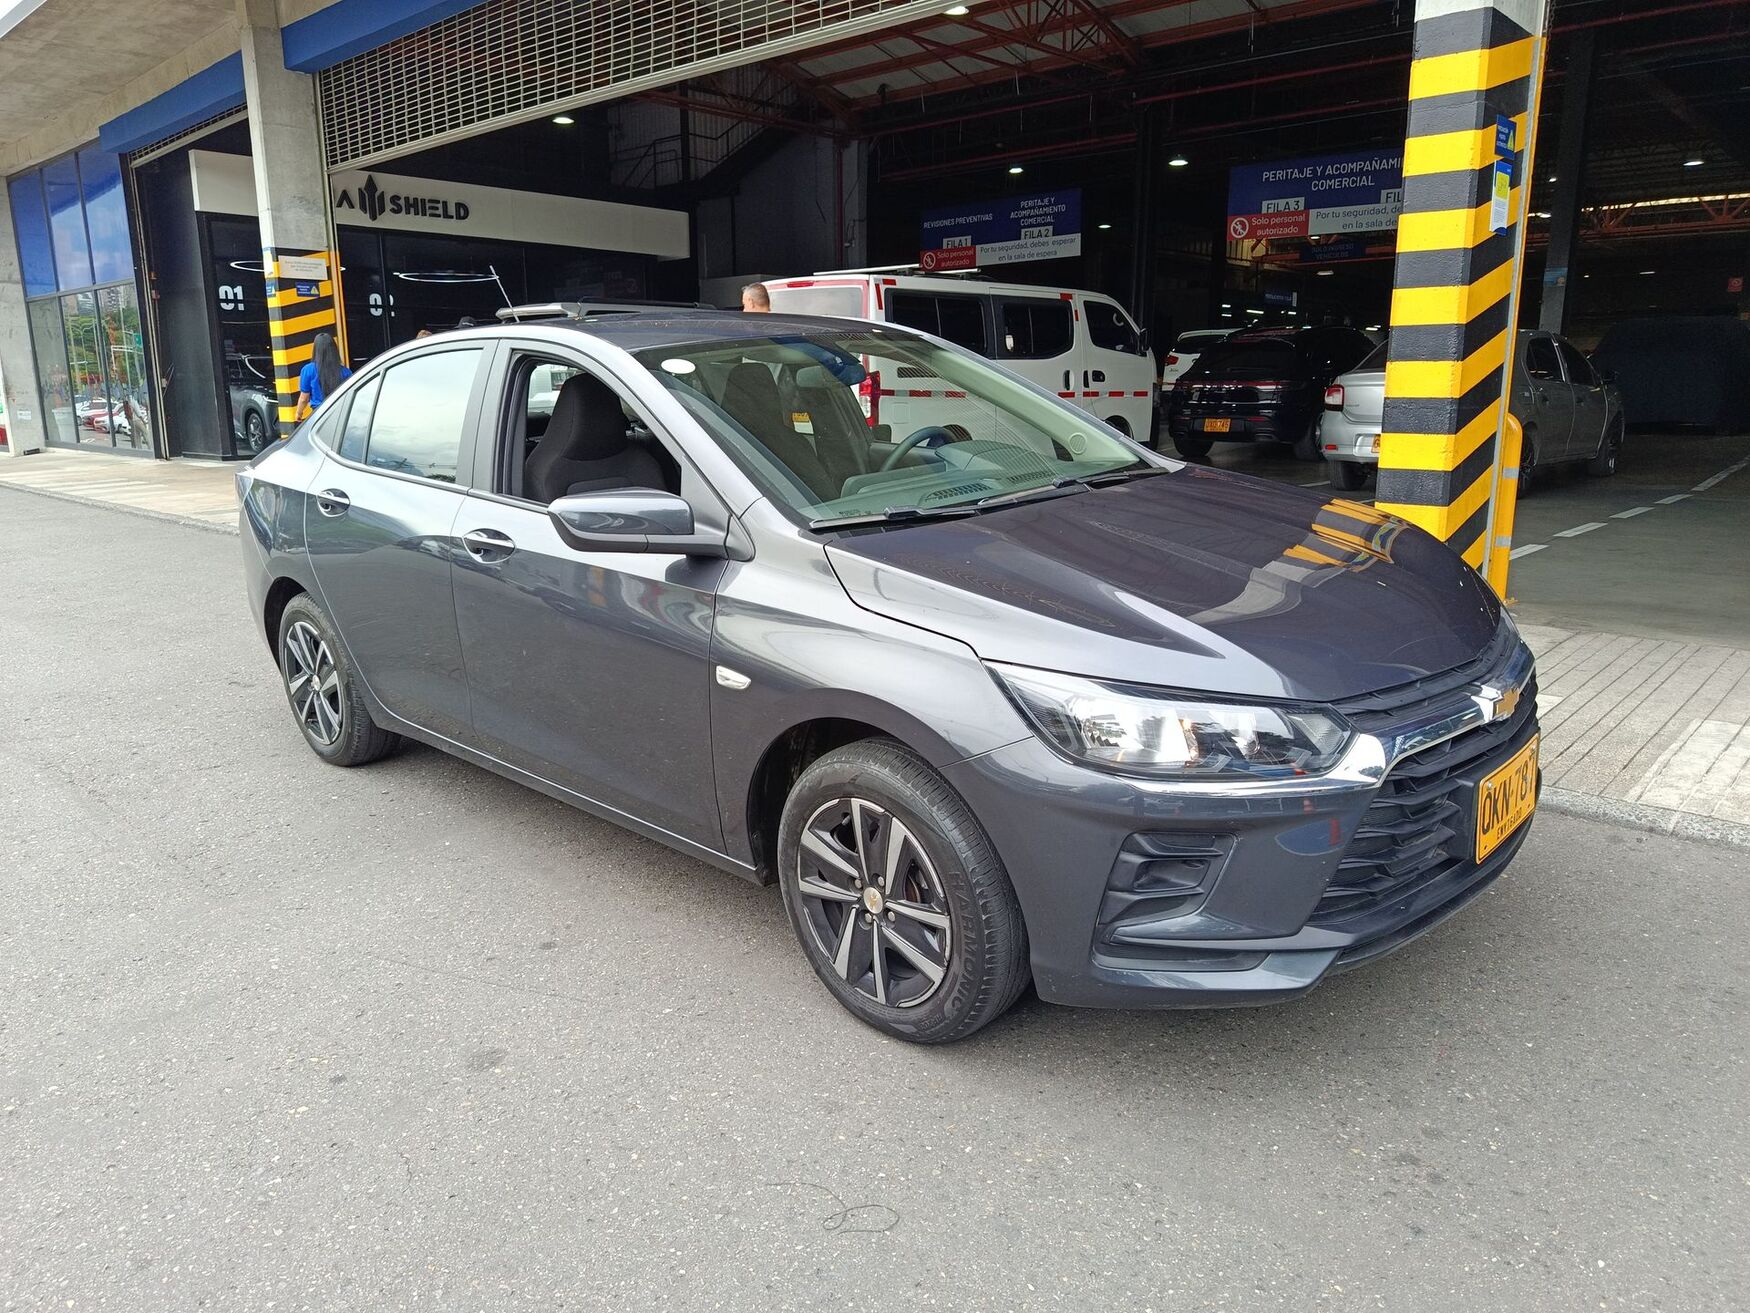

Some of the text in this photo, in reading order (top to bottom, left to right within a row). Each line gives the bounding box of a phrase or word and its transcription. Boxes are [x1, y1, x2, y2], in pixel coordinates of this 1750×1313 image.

[1262, 157, 1401, 182] PERITAJE Y ACOMPAÑAMI
[1311, 175, 1375, 191] COMERCIAL
[1020, 198, 1049, 208] PERITAJE
[1385, 191, 1401, 203] FIL
[389, 194, 470, 220] SHIELD
[1266, 199, 1300, 213] FILA 3
[1316, 205, 1401, 220] Por tu seguridad, de
[923, 213, 993, 229] REVISIONES PREVENTIVAS
[1020, 215, 1055, 226] COMERCIAL
[1251, 213, 1306, 226] Solo personal
[1342, 222, 1352, 230] en
[1356, 221, 1364, 229] la
[1365, 219, 1383, 229] sala
[1024, 228, 1050, 240] FILA 2
[1256, 226, 1299, 236] autorizado
[946, 238, 964, 248] FILA
[1052, 236, 1076, 247] esperar
[950, 249, 974, 259] personal
[941, 258, 970, 268] autorizado
[218, 285, 245, 311] 01
